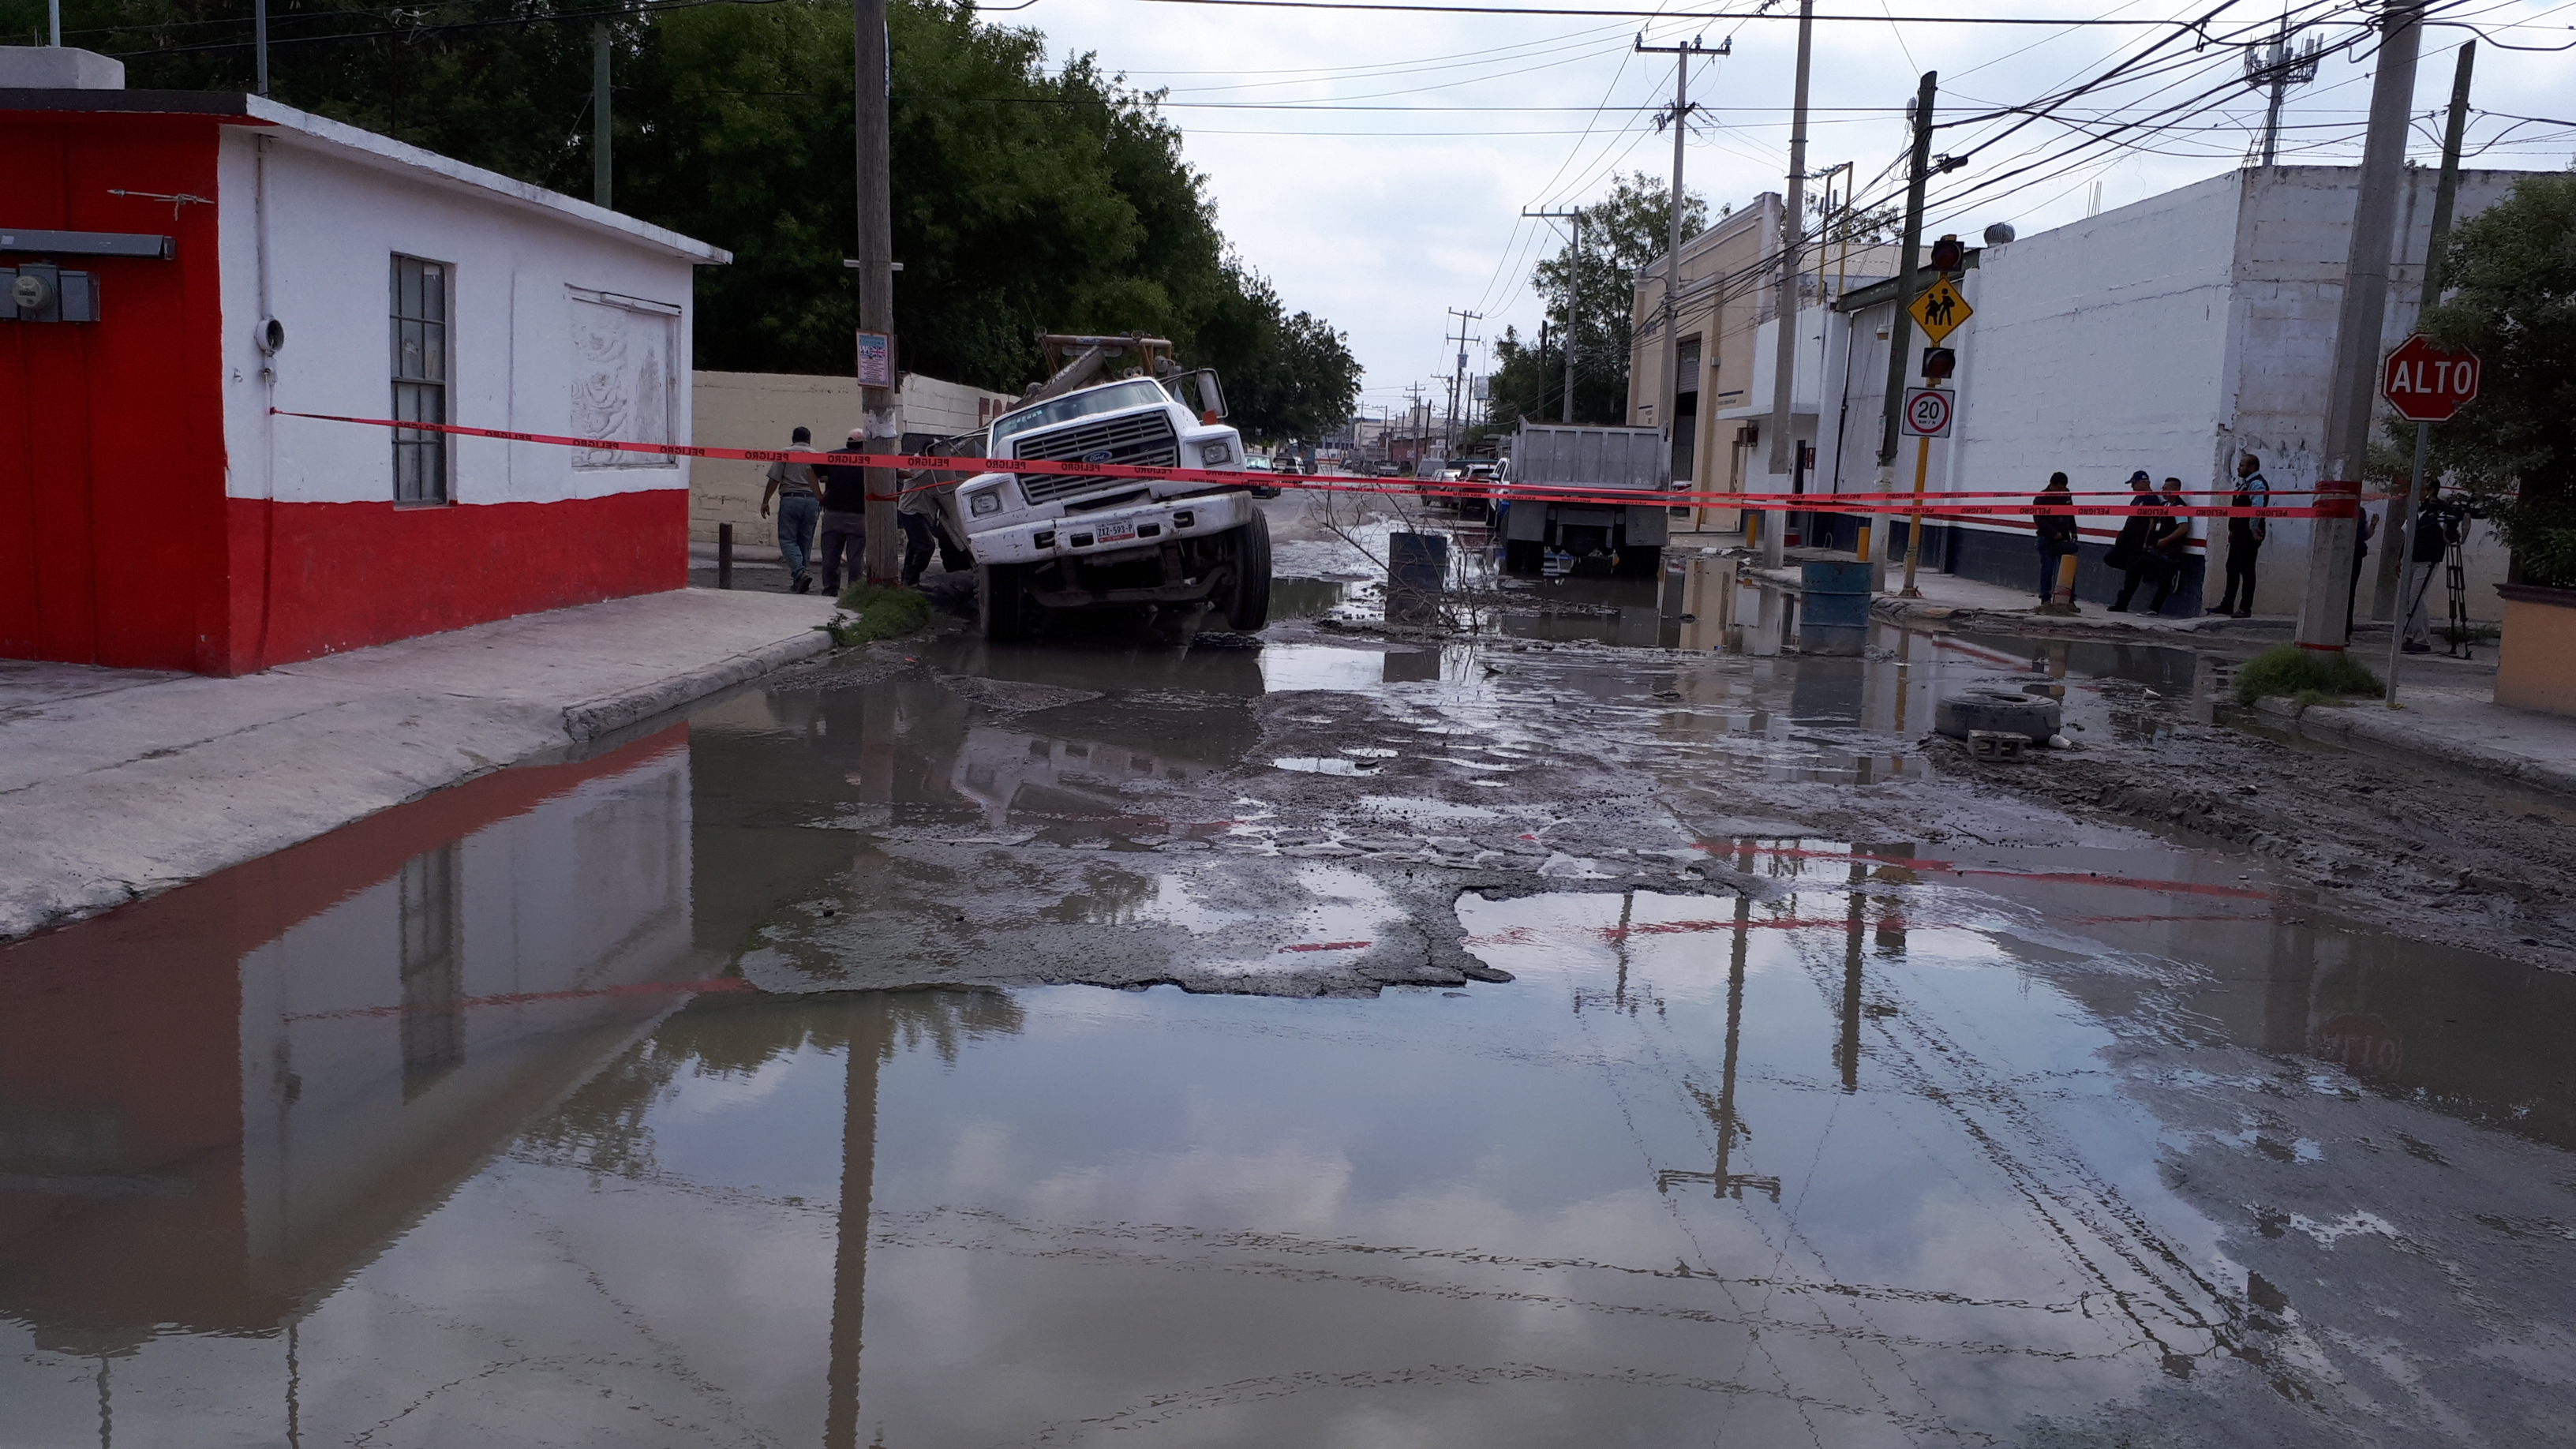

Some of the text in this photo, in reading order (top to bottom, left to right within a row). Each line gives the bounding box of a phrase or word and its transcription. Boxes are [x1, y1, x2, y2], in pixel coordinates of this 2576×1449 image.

[2391, 361, 2472, 395] ALTO
[1918, 401, 1939, 419] 20
[2196, 508, 2228, 517] PELIGRO
